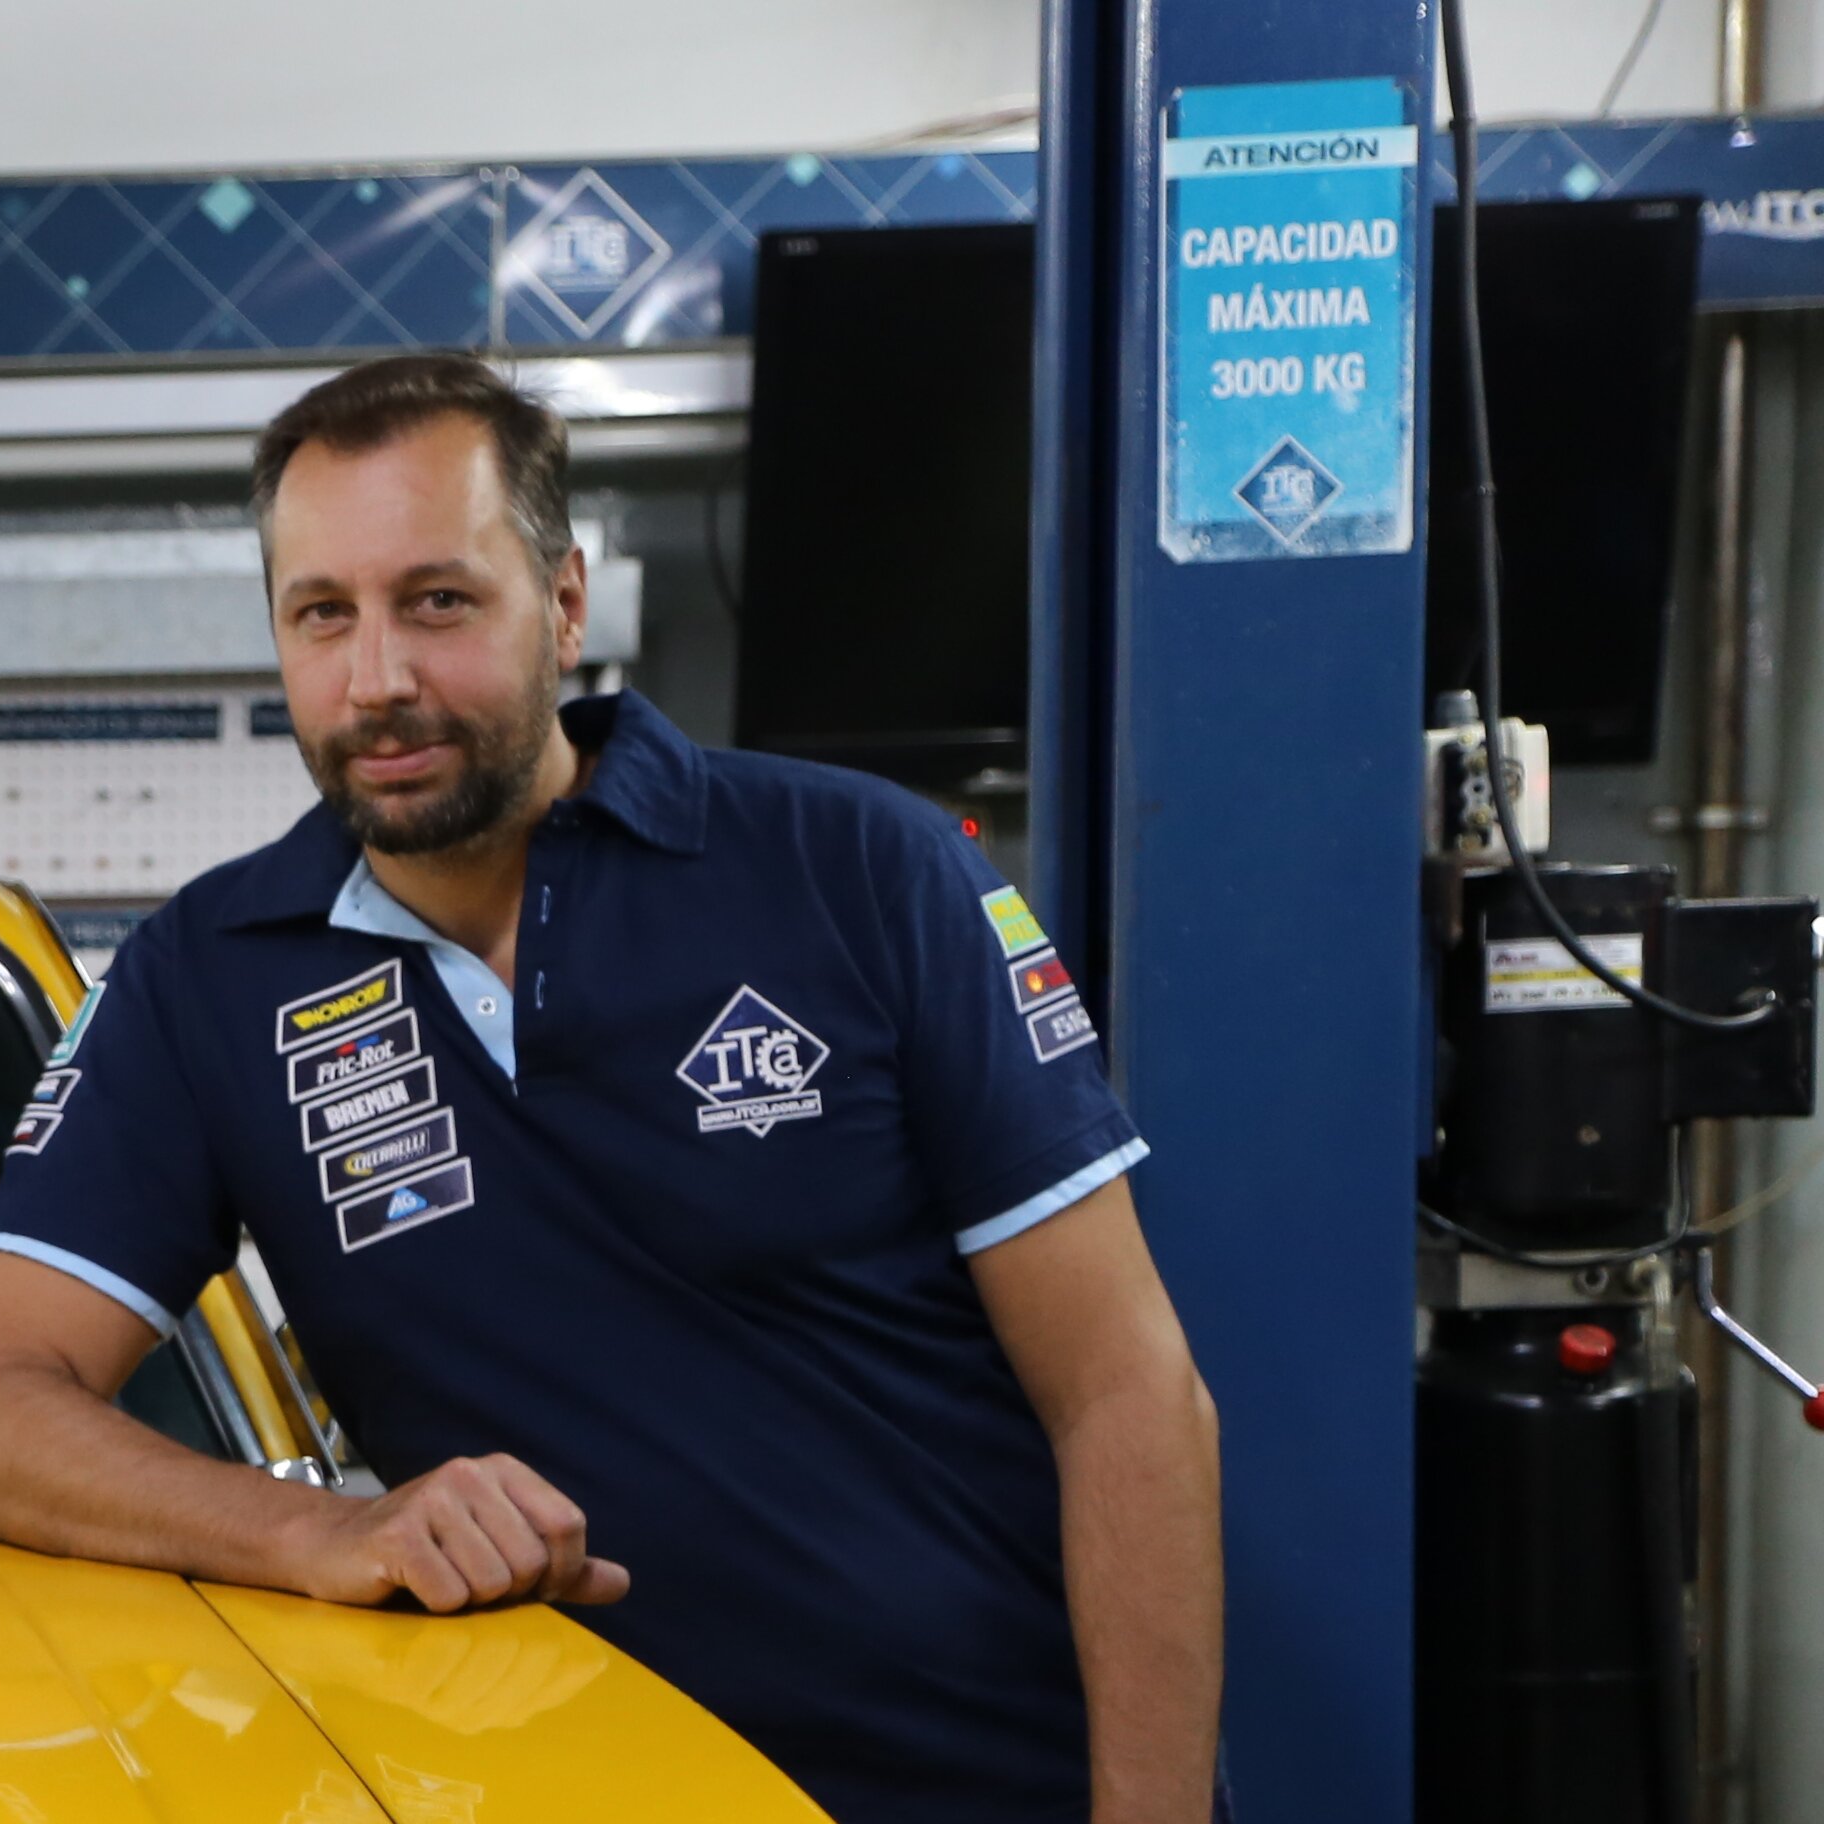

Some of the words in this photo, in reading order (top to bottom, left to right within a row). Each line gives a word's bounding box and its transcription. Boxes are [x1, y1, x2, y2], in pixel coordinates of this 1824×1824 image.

[1203, 134, 1380, 169] ATENCIÓN
[1181, 219, 1398, 268] CAPACIDAD
[1209, 282, 1371, 334] MÁXIMA
[1210, 356, 1303, 399] 3000
[1314, 352, 1367, 394] KG
[291, 977, 387, 1031] MONROE
[316, 1039, 395, 1087] Fric-Rot
[323, 1079, 410, 1132] BREMEN
